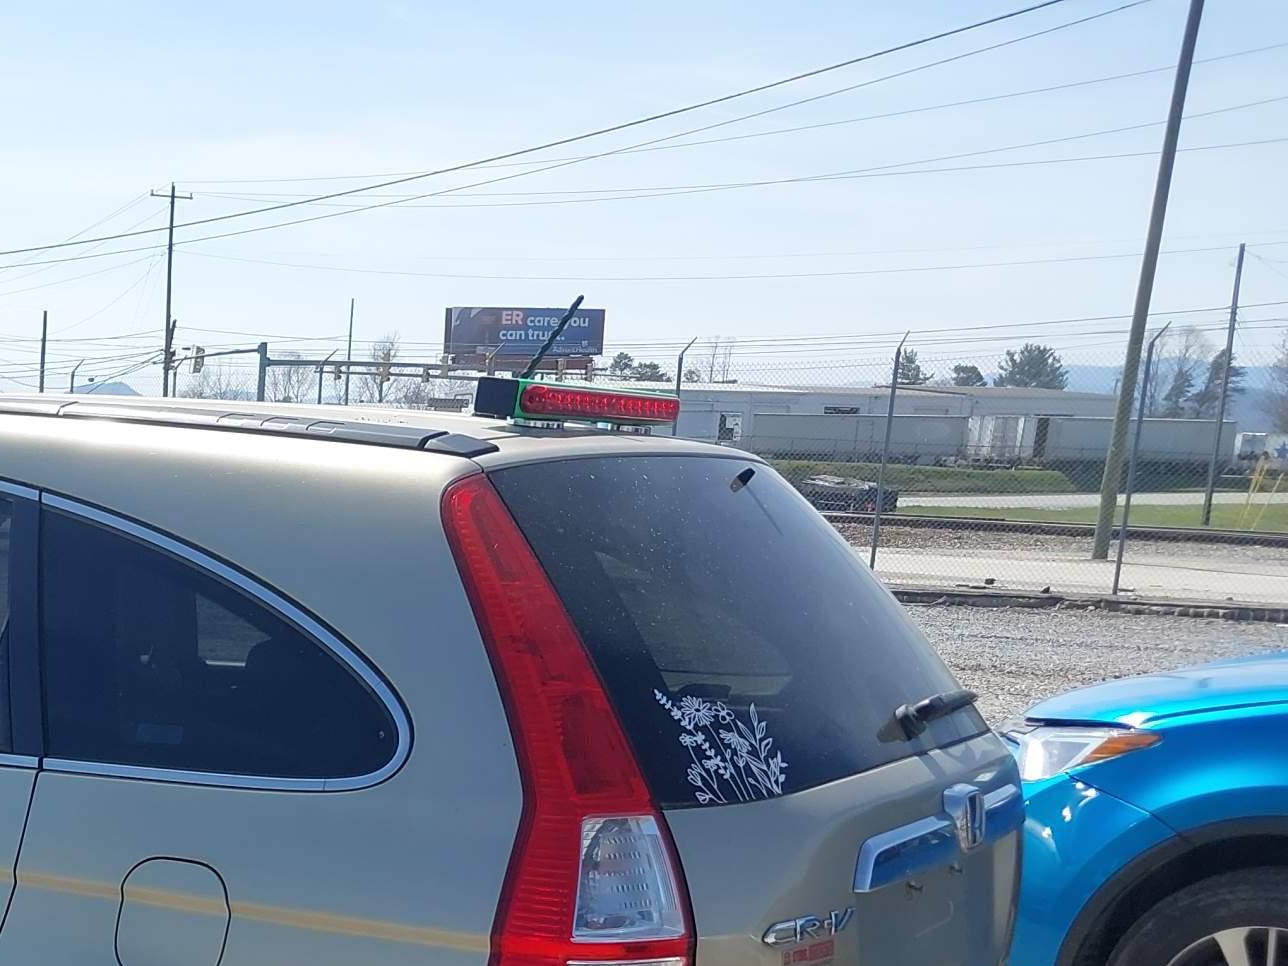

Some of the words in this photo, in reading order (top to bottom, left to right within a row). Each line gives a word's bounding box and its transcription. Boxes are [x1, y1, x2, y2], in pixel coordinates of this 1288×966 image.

[502, 311, 523, 325] ER
[527, 316, 558, 327] care
[499, 329, 525, 340] can
[762, 907, 856, 945] CR-V
